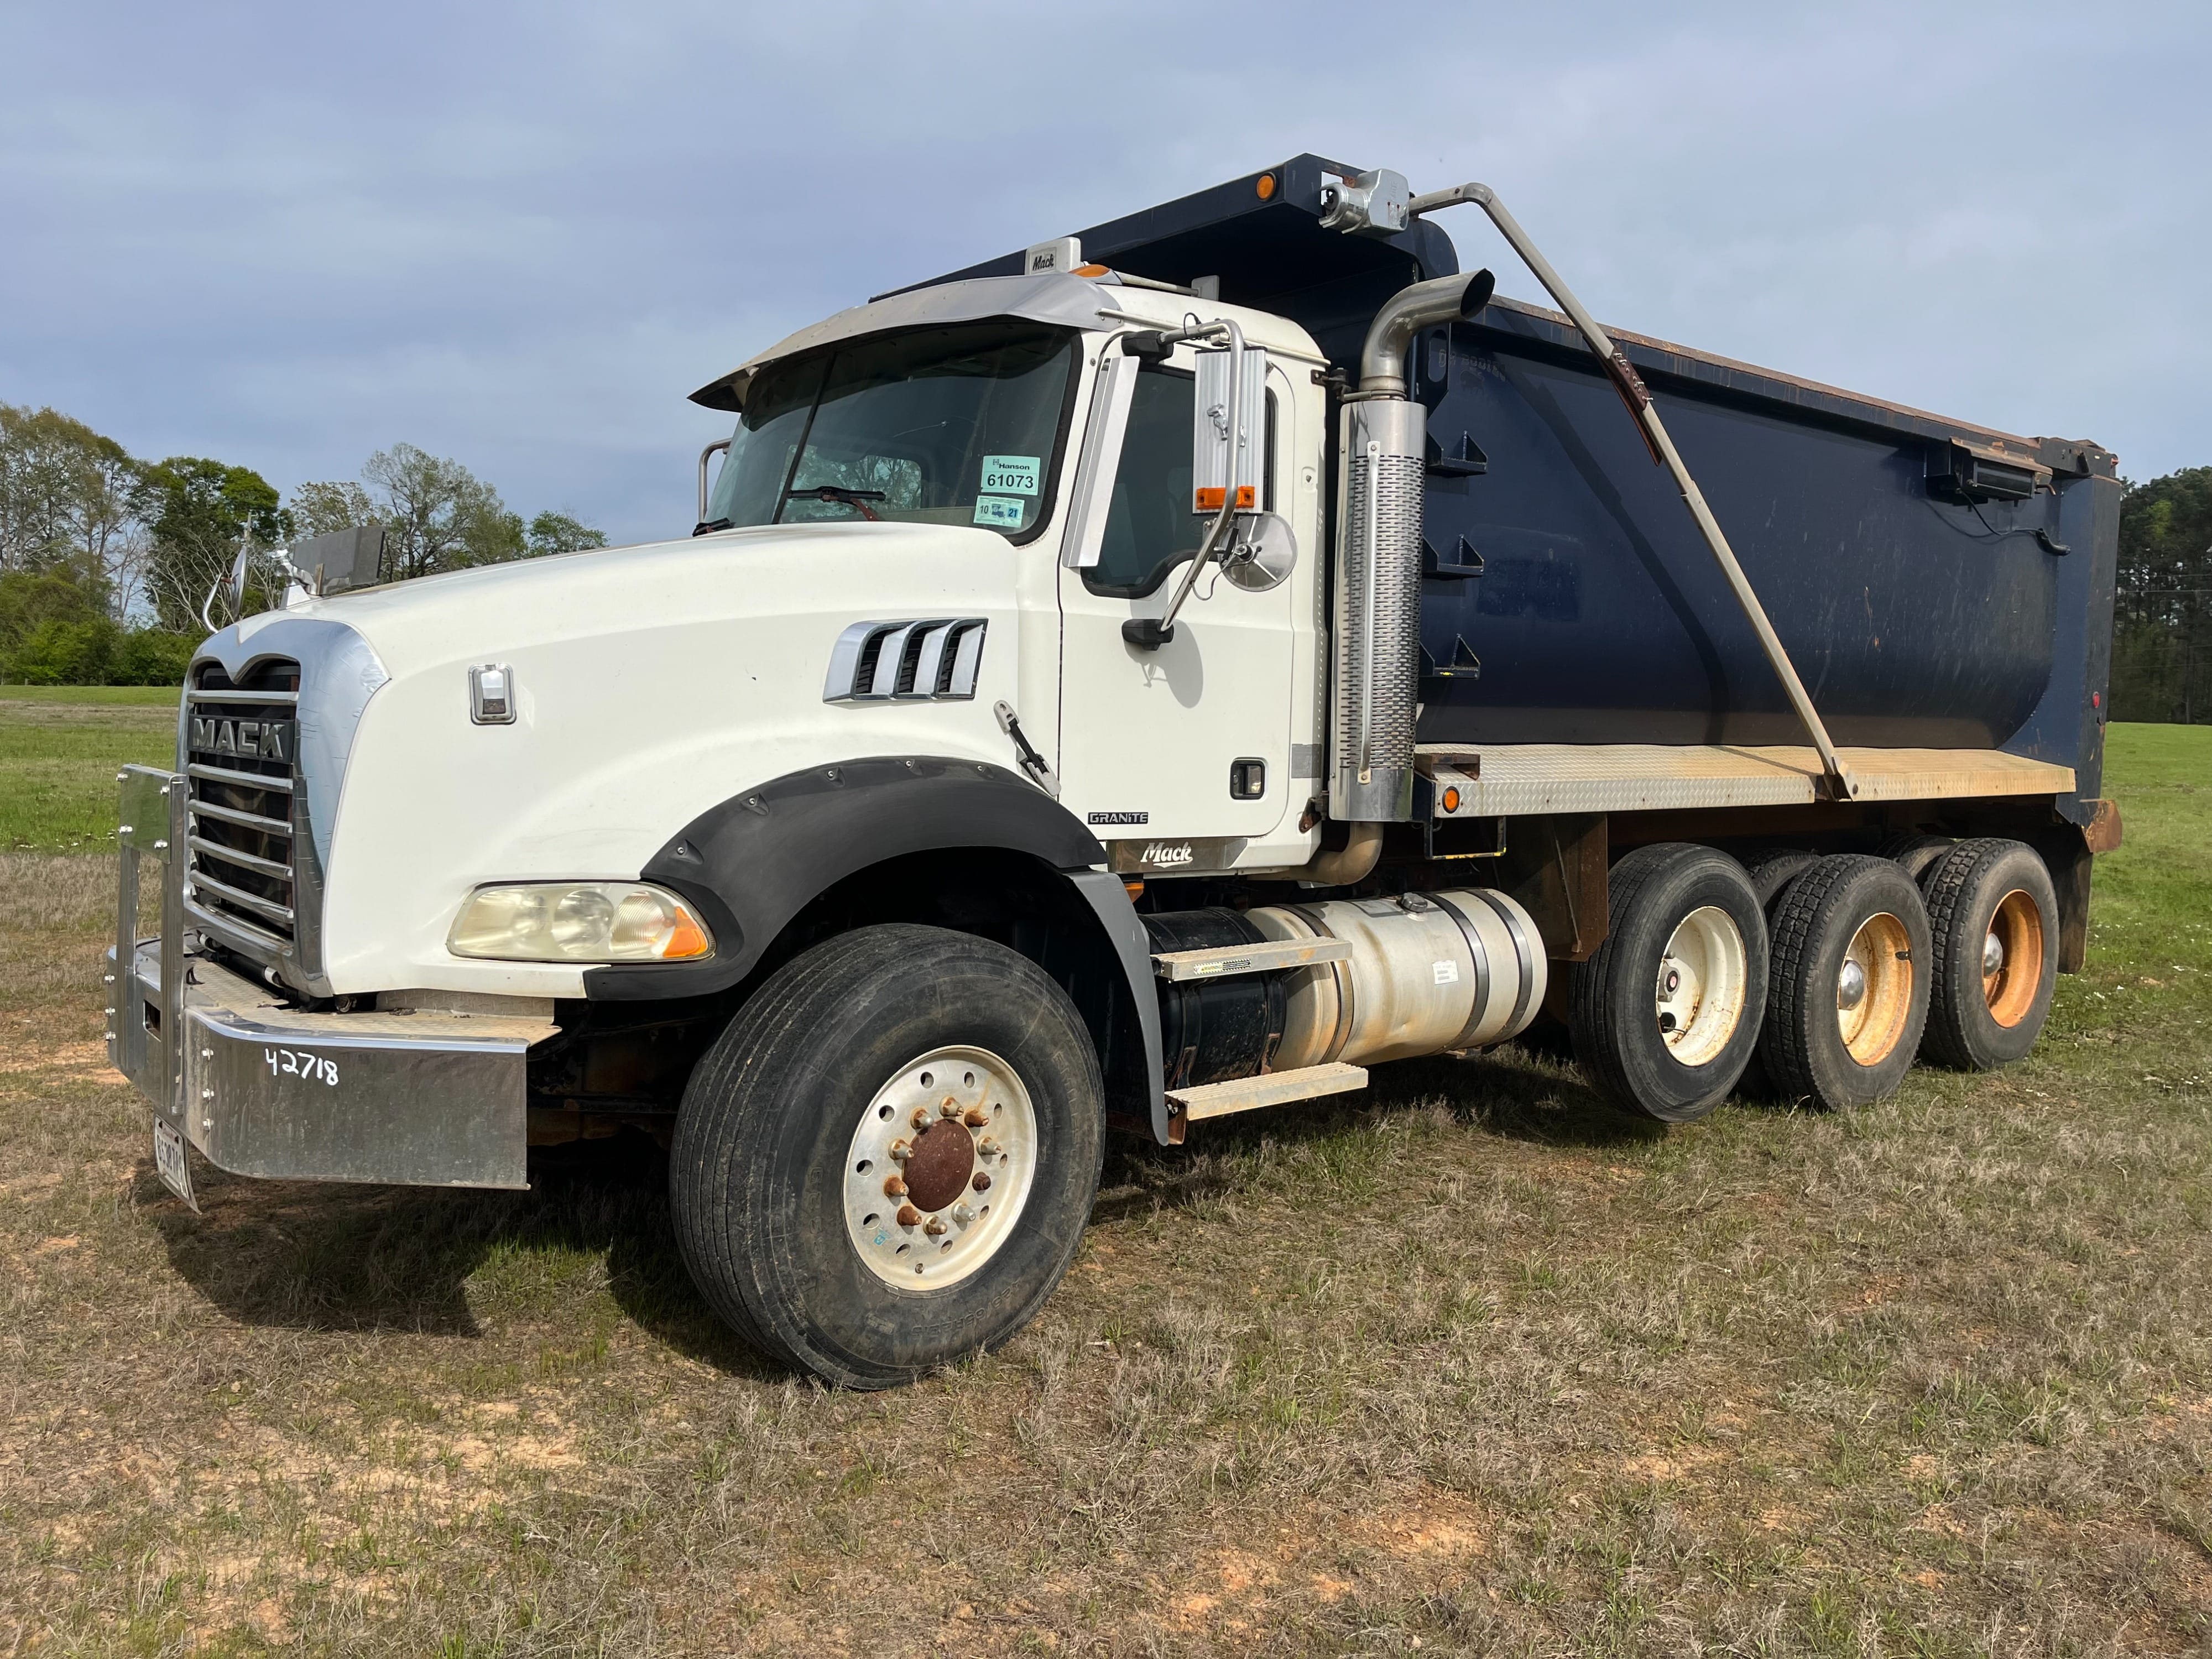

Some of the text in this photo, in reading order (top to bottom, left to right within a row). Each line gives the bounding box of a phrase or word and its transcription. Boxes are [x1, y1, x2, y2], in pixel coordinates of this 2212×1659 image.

[1032, 254, 1054, 270] Mack
[988, 474, 1034, 488] 61073
[980, 505, 1017, 517] 10 21
[194, 718, 285, 759] MACK
[1089, 813, 1147, 823] GRANITE
[1140, 842, 1193, 868] Mack
[265, 1048, 339, 1086] 42718
